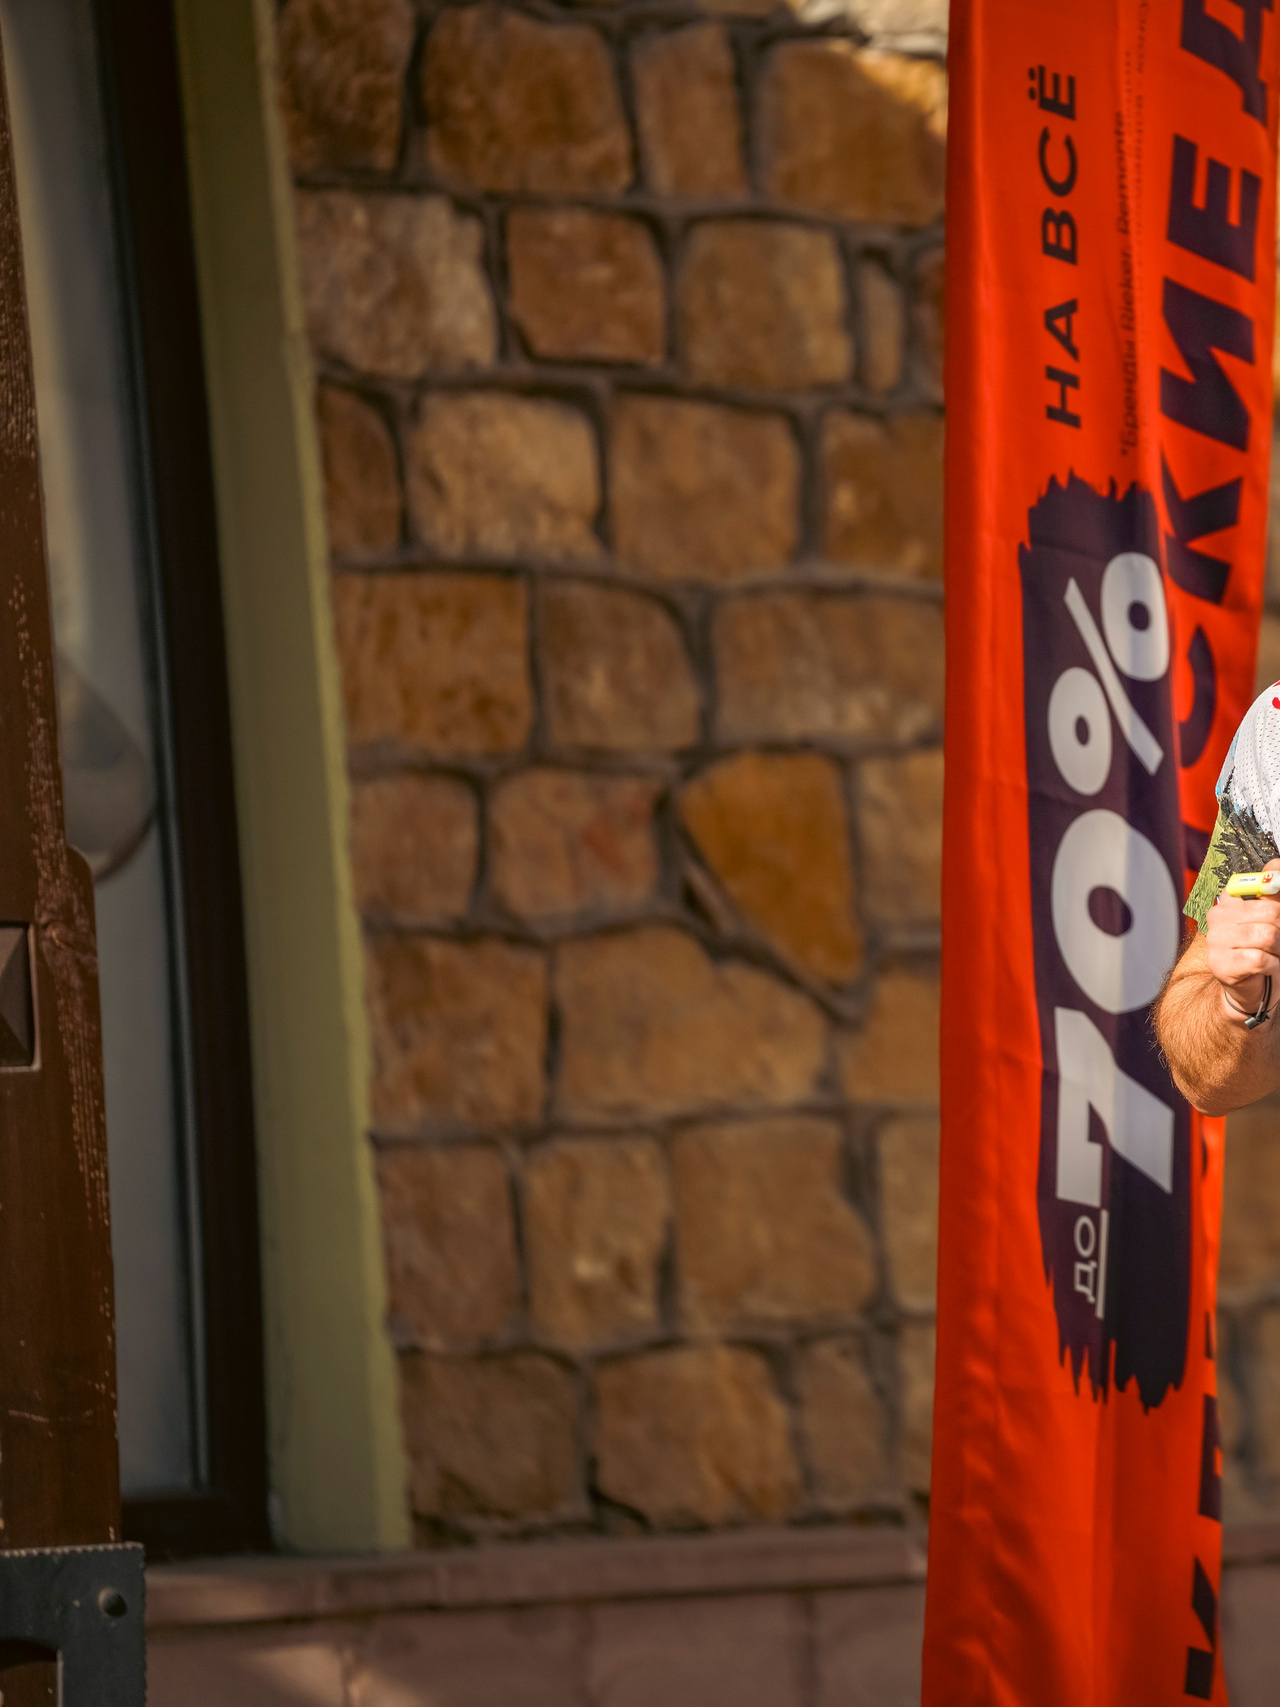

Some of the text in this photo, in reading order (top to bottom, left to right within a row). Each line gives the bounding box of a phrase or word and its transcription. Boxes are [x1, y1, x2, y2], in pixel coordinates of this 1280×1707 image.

[1028, 65, 1082, 429] НА ВСЁ
[1048, 552, 1174, 1306] ДО 70%
